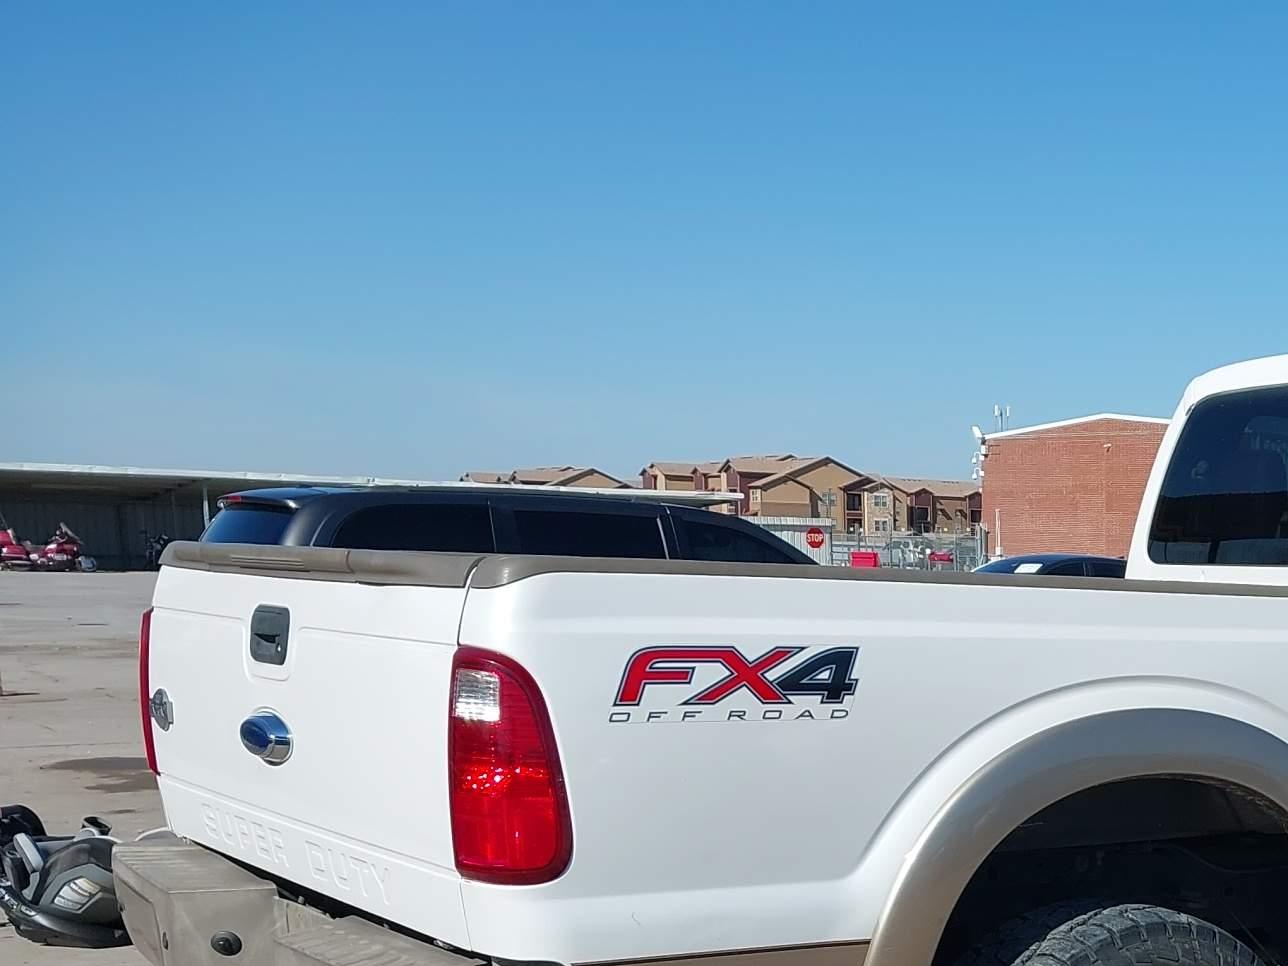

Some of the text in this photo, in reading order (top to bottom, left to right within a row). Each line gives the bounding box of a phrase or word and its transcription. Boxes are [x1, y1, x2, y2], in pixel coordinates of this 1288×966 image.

[807, 533, 824, 543] STOP
[613, 646, 860, 707] FX4
[608, 708, 850, 723] OFF ROAD
[201, 802, 393, 906] SUPER DUTY
